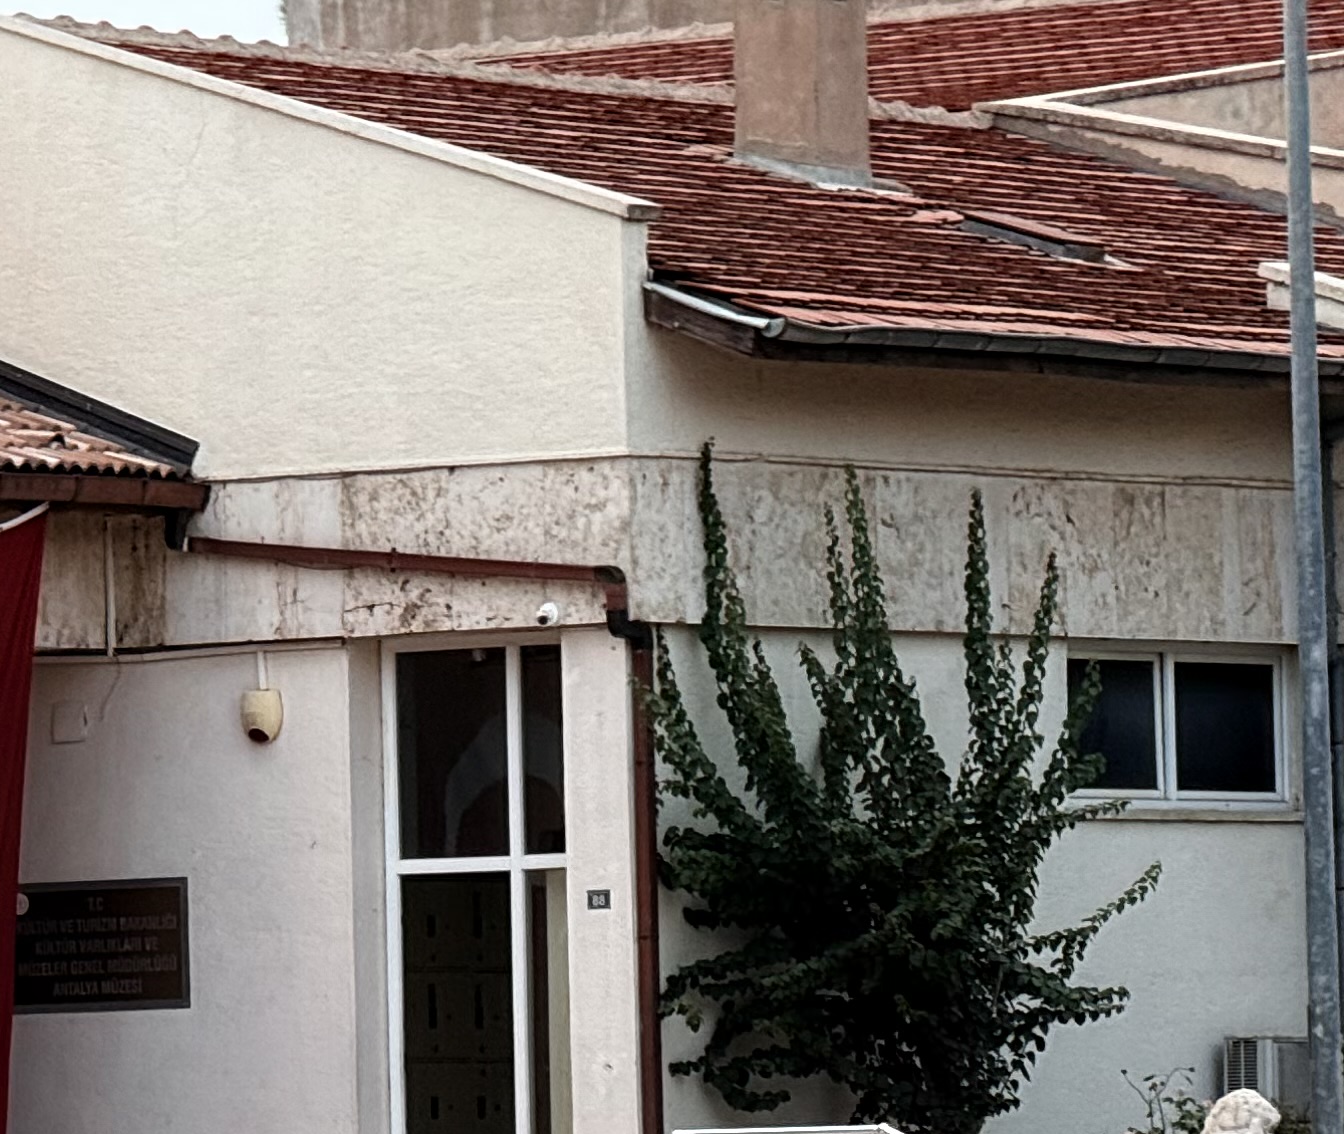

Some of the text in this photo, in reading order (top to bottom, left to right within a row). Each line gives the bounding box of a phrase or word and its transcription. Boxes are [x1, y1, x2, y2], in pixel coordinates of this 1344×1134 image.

[60, 919, 74, 933] VE
[36, 937, 76, 955] KÜLTÜR
[144, 936, 160, 951] VE
[70, 959, 105, 975] GENEL
[53, 976, 143, 996] ANTALYA MÜZESİ
